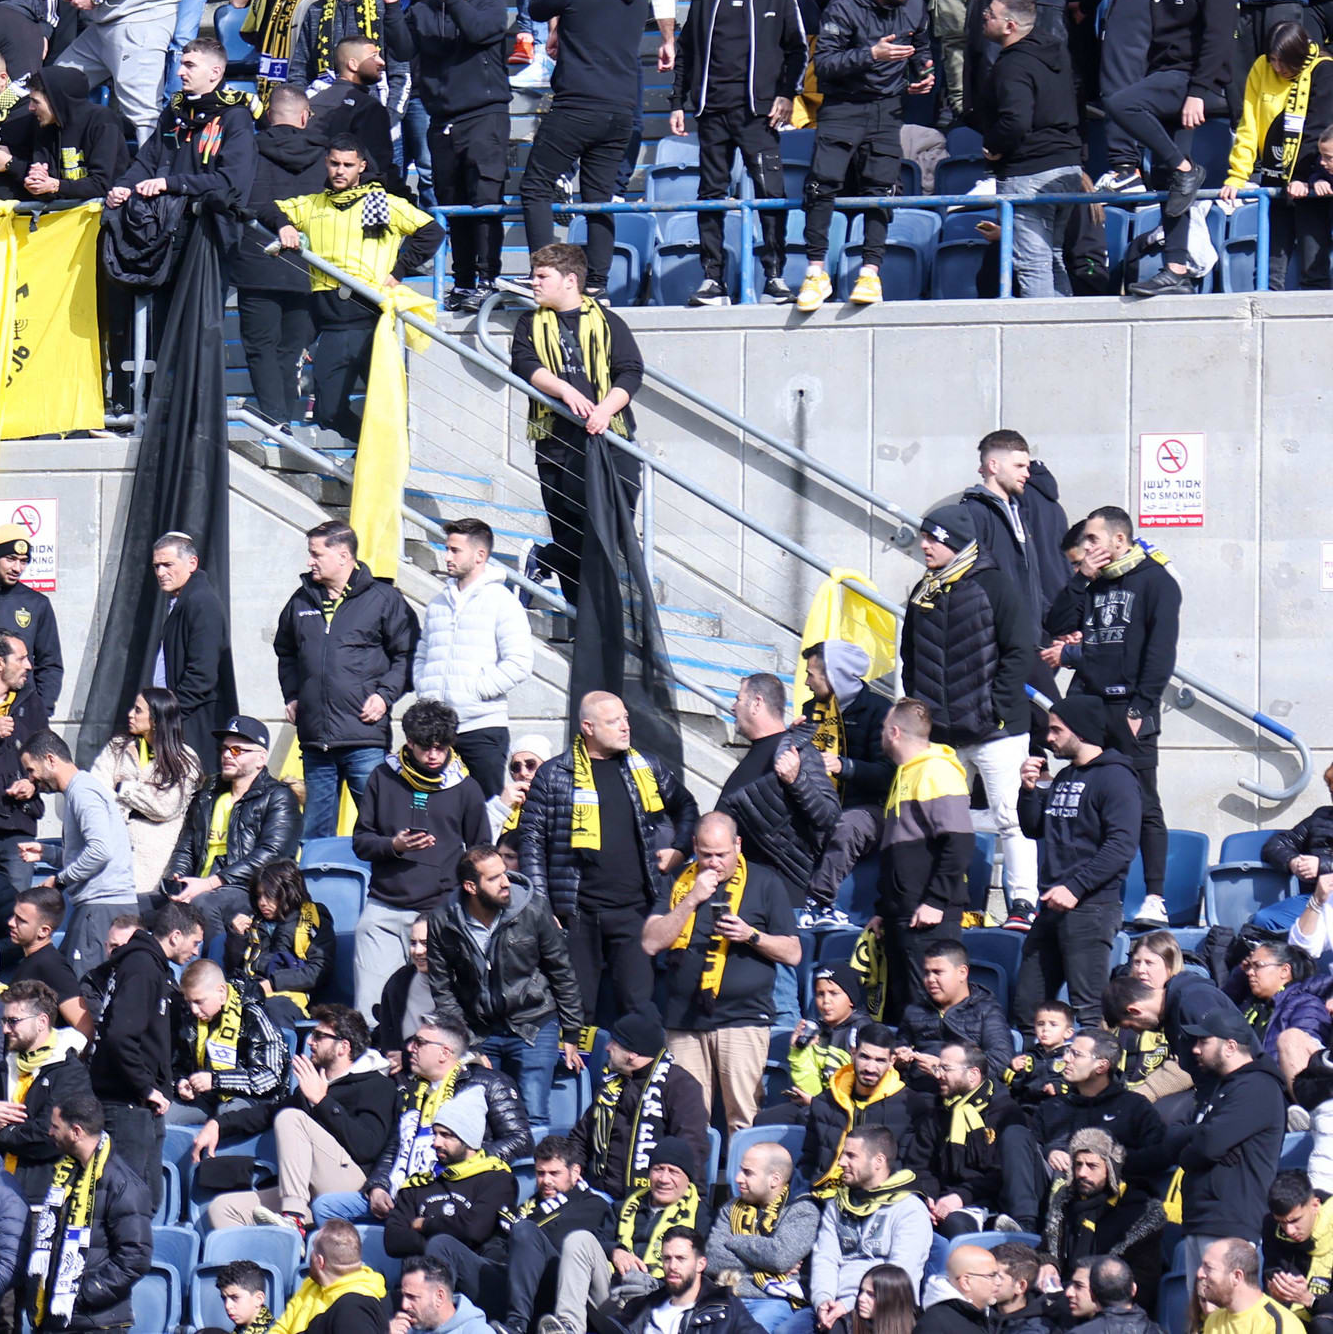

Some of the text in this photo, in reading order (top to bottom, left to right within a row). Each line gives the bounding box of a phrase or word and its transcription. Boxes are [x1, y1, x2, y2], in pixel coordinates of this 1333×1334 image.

[1143, 477, 1202, 490] אסור לעשן
[1143, 491, 1202, 500] NO SMOKING
[31, 556, 54, 564] KING
